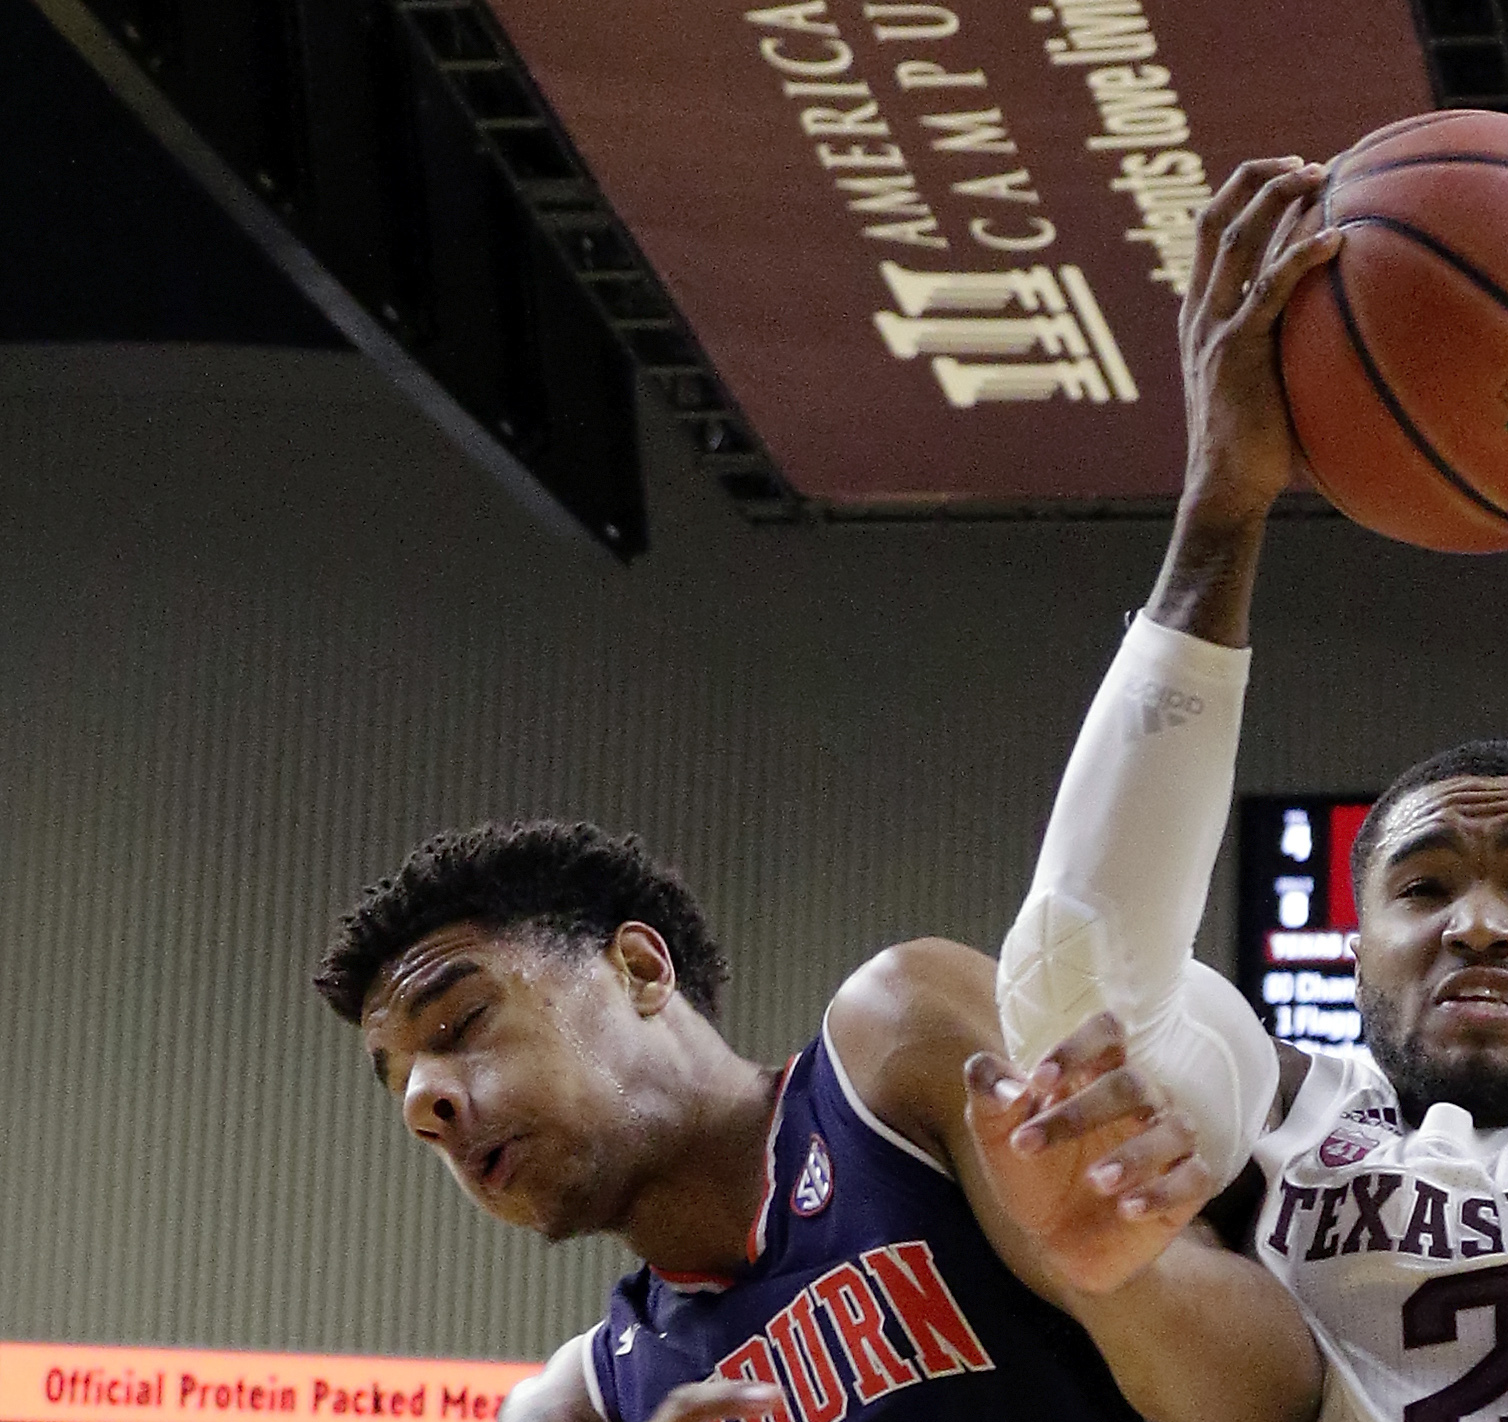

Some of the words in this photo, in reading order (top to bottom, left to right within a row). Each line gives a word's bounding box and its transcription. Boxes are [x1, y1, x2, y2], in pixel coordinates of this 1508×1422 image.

[1029, 0, 1158, 66] livi
[743, 0, 948, 250] AMERICA
[862, 3, 1057, 252] CAMPU
[1085, 63, 1192, 151] love
[1267, 1173, 1503, 1264] TEXAS
[46, 1366, 164, 1407] Official
[179, 1372, 297, 1411] Protein
[312, 1378, 427, 1417] Packed
